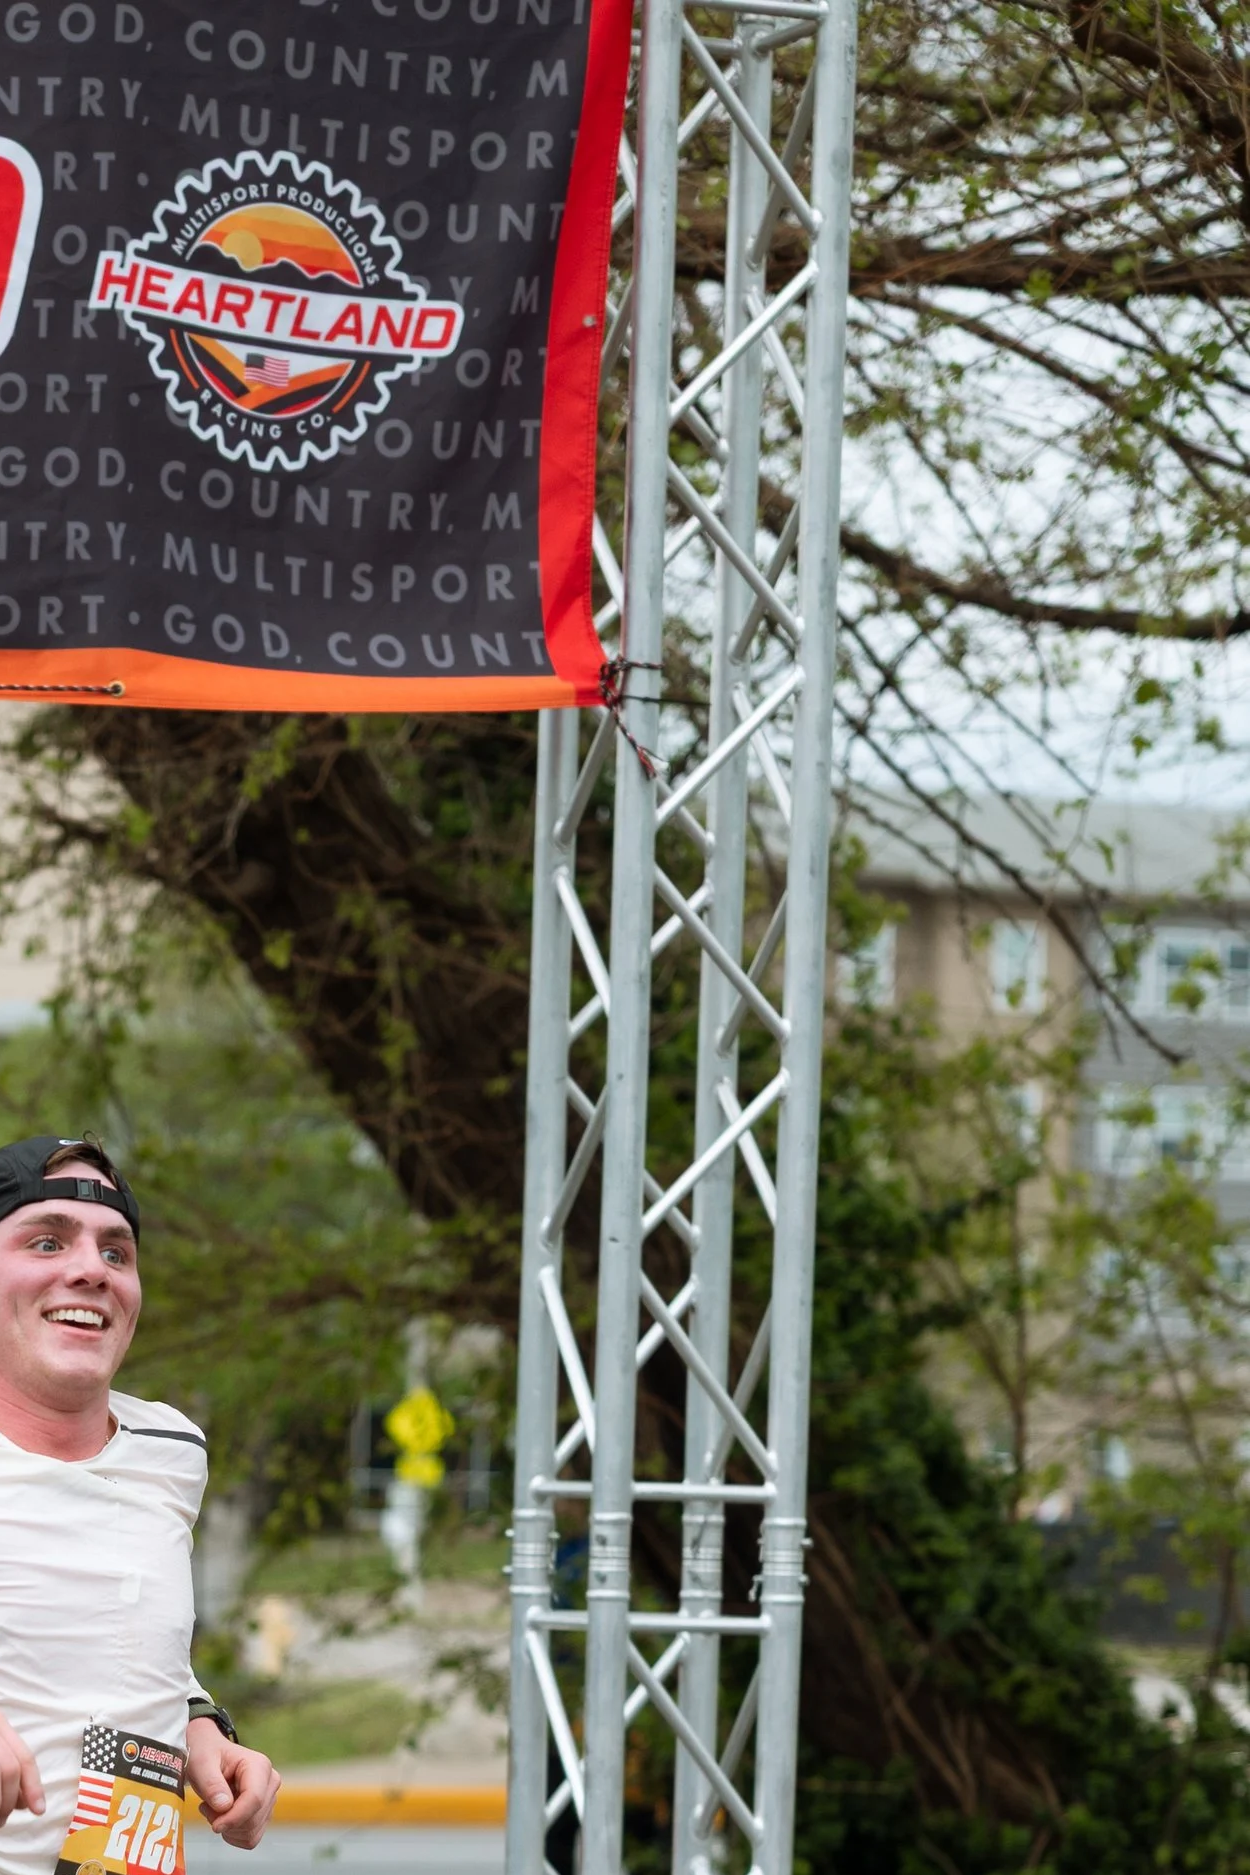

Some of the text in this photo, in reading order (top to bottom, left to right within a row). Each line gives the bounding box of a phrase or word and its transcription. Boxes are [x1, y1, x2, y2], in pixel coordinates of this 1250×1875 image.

[185, 20, 497, 101] COUNTRY,
[170, 183, 380, 287] MULTISPORT PRODUCTIONS
[96, 257, 458, 350] HEARTLAND
[200, 388, 282, 439] RACING
[160, 460, 454, 534] COUNTRY,
[103, 1794, 179, 1875] 2123
